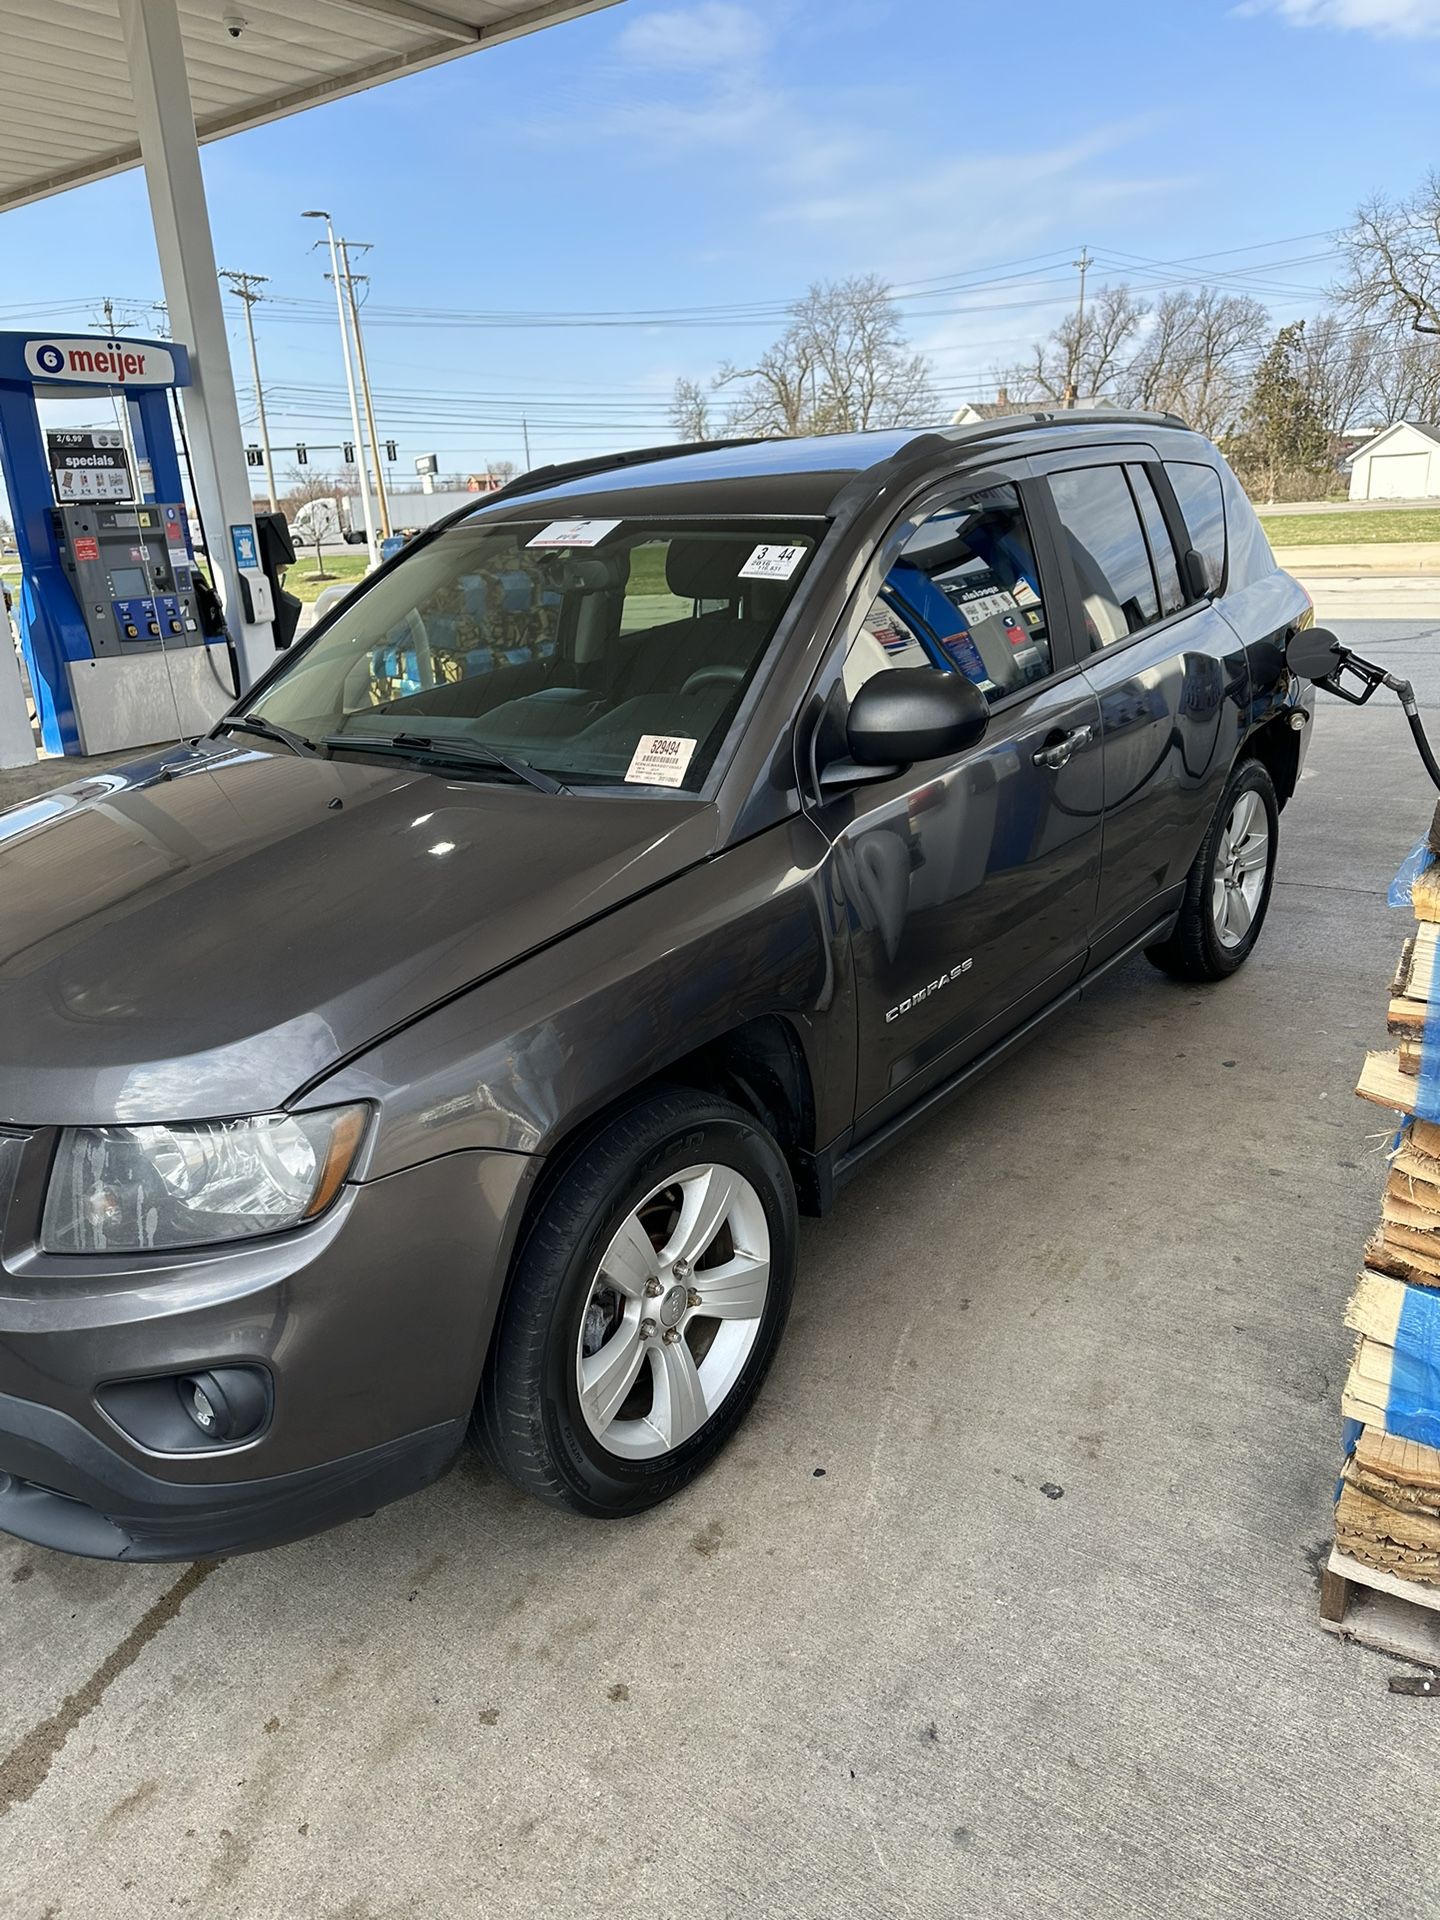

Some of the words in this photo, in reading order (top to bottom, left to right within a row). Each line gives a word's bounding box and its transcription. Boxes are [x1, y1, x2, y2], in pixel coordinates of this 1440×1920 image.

[43, 351, 58, 367] 6
[68, 343, 145, 381] meijer
[65, 454, 115, 468] specials
[757, 547, 769, 560] 3
[778, 547, 796, 560] 44
[650, 740, 681, 756] 529494
[885, 957, 974, 1024] COMPASS
